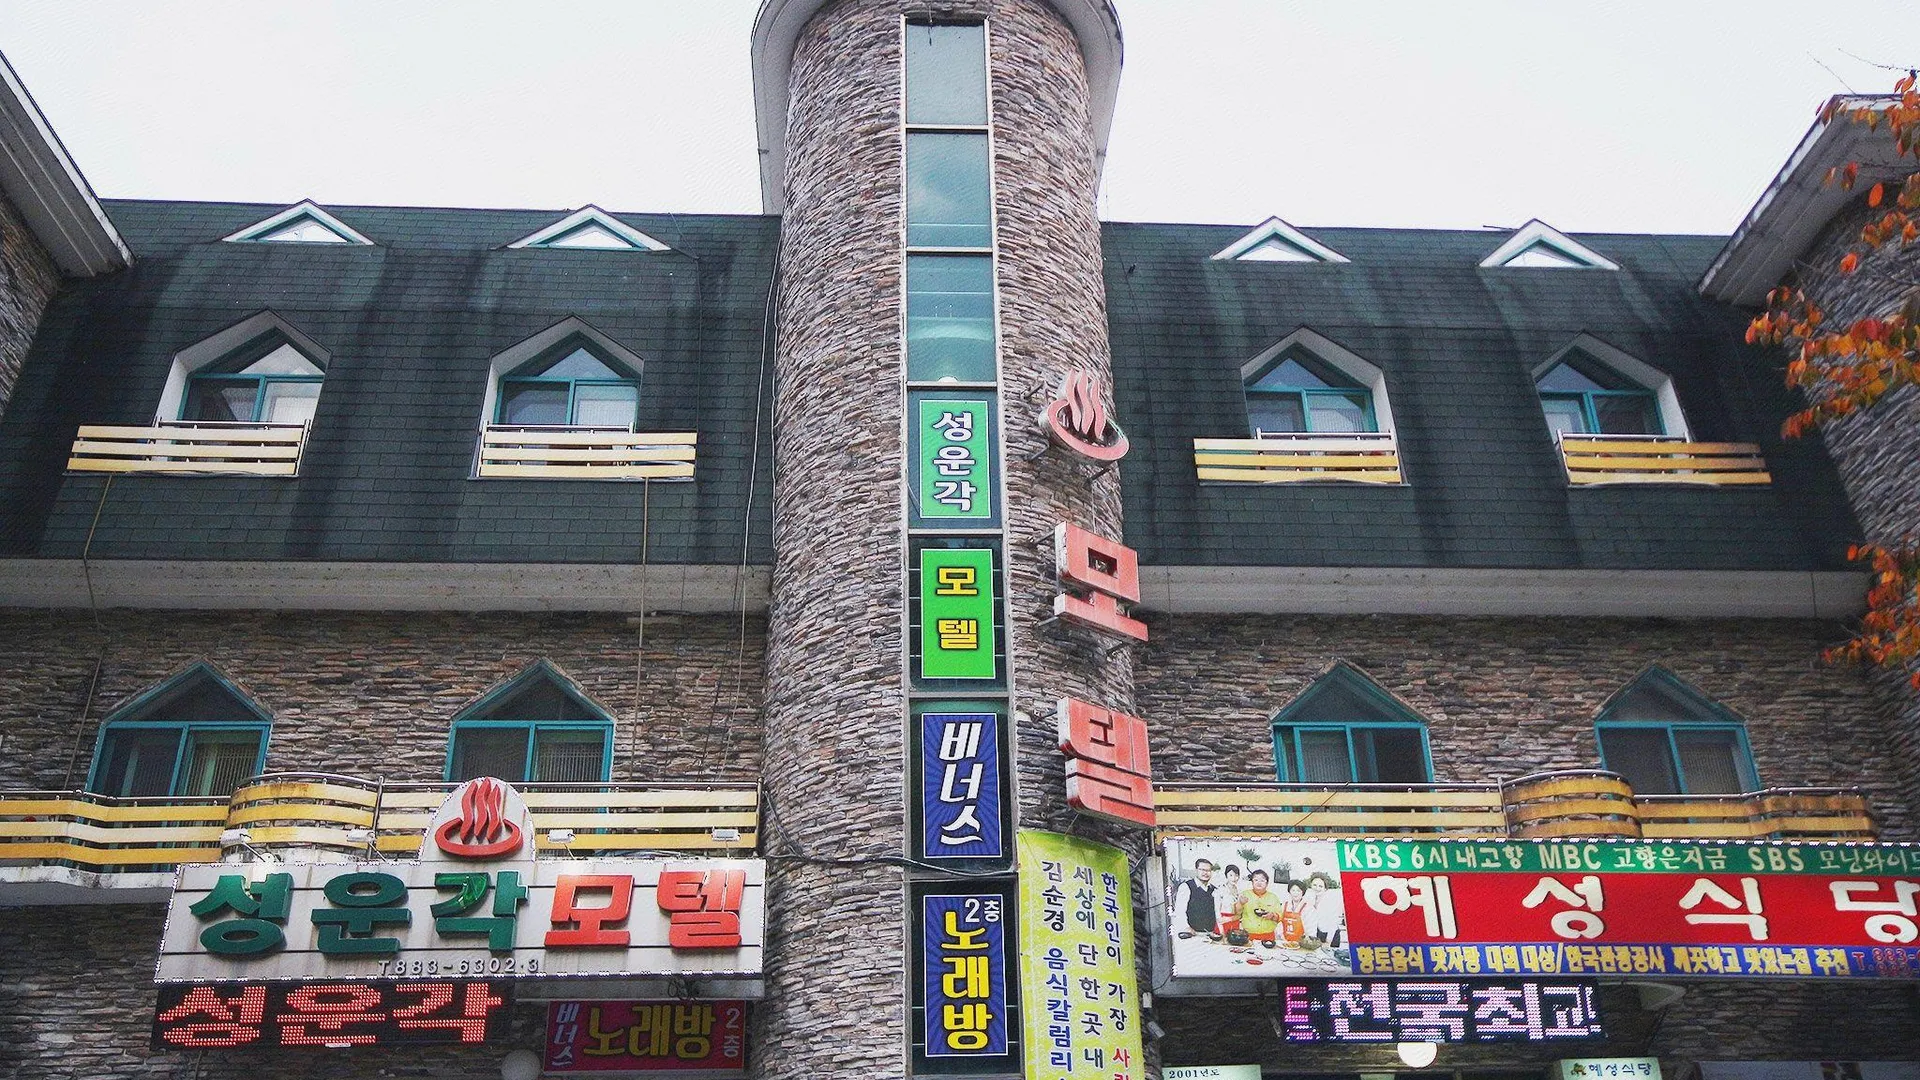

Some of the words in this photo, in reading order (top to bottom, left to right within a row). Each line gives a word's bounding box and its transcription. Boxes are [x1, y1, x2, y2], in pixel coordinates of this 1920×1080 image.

[932, 411, 977, 511] 성운각
[936, 567, 977, 649] 모텔
[939, 723, 983, 845] 비너스
[1344, 845, 1402, 869] KBS
[1456, 844, 1524, 869] 내고향
[1540, 845, 1602, 870] MBC
[1613, 846, 1727, 871] 고향은지금
[1749, 847, 1805, 871] SBS
[965, 899, 999, 923] 2층
[1041, 861, 1067, 931] 김순경
[1073, 866, 1096, 930] 세상에
[1101, 872, 1122, 965] 한국인이
[1360, 875, 1920, 943] 혜성식당
[941, 911, 993, 1049] 노래방
[1357, 946, 1425, 973] 향토음식
[1430, 946, 1481, 973] 맛자랑
[1814, 948, 1850, 975] 추천
[158, 983, 502, 1046] 성운각
[551, 1003, 580, 1065] 비너스
[583, 1004, 716, 1059] 노래방
[723, 1008, 741, 1058] 2층
[1043, 947, 1073, 1080] 음식칼럼리
[1108, 983, 1128, 1031] 가장
[1588, 1063, 1652, 1076] 혜성식당
